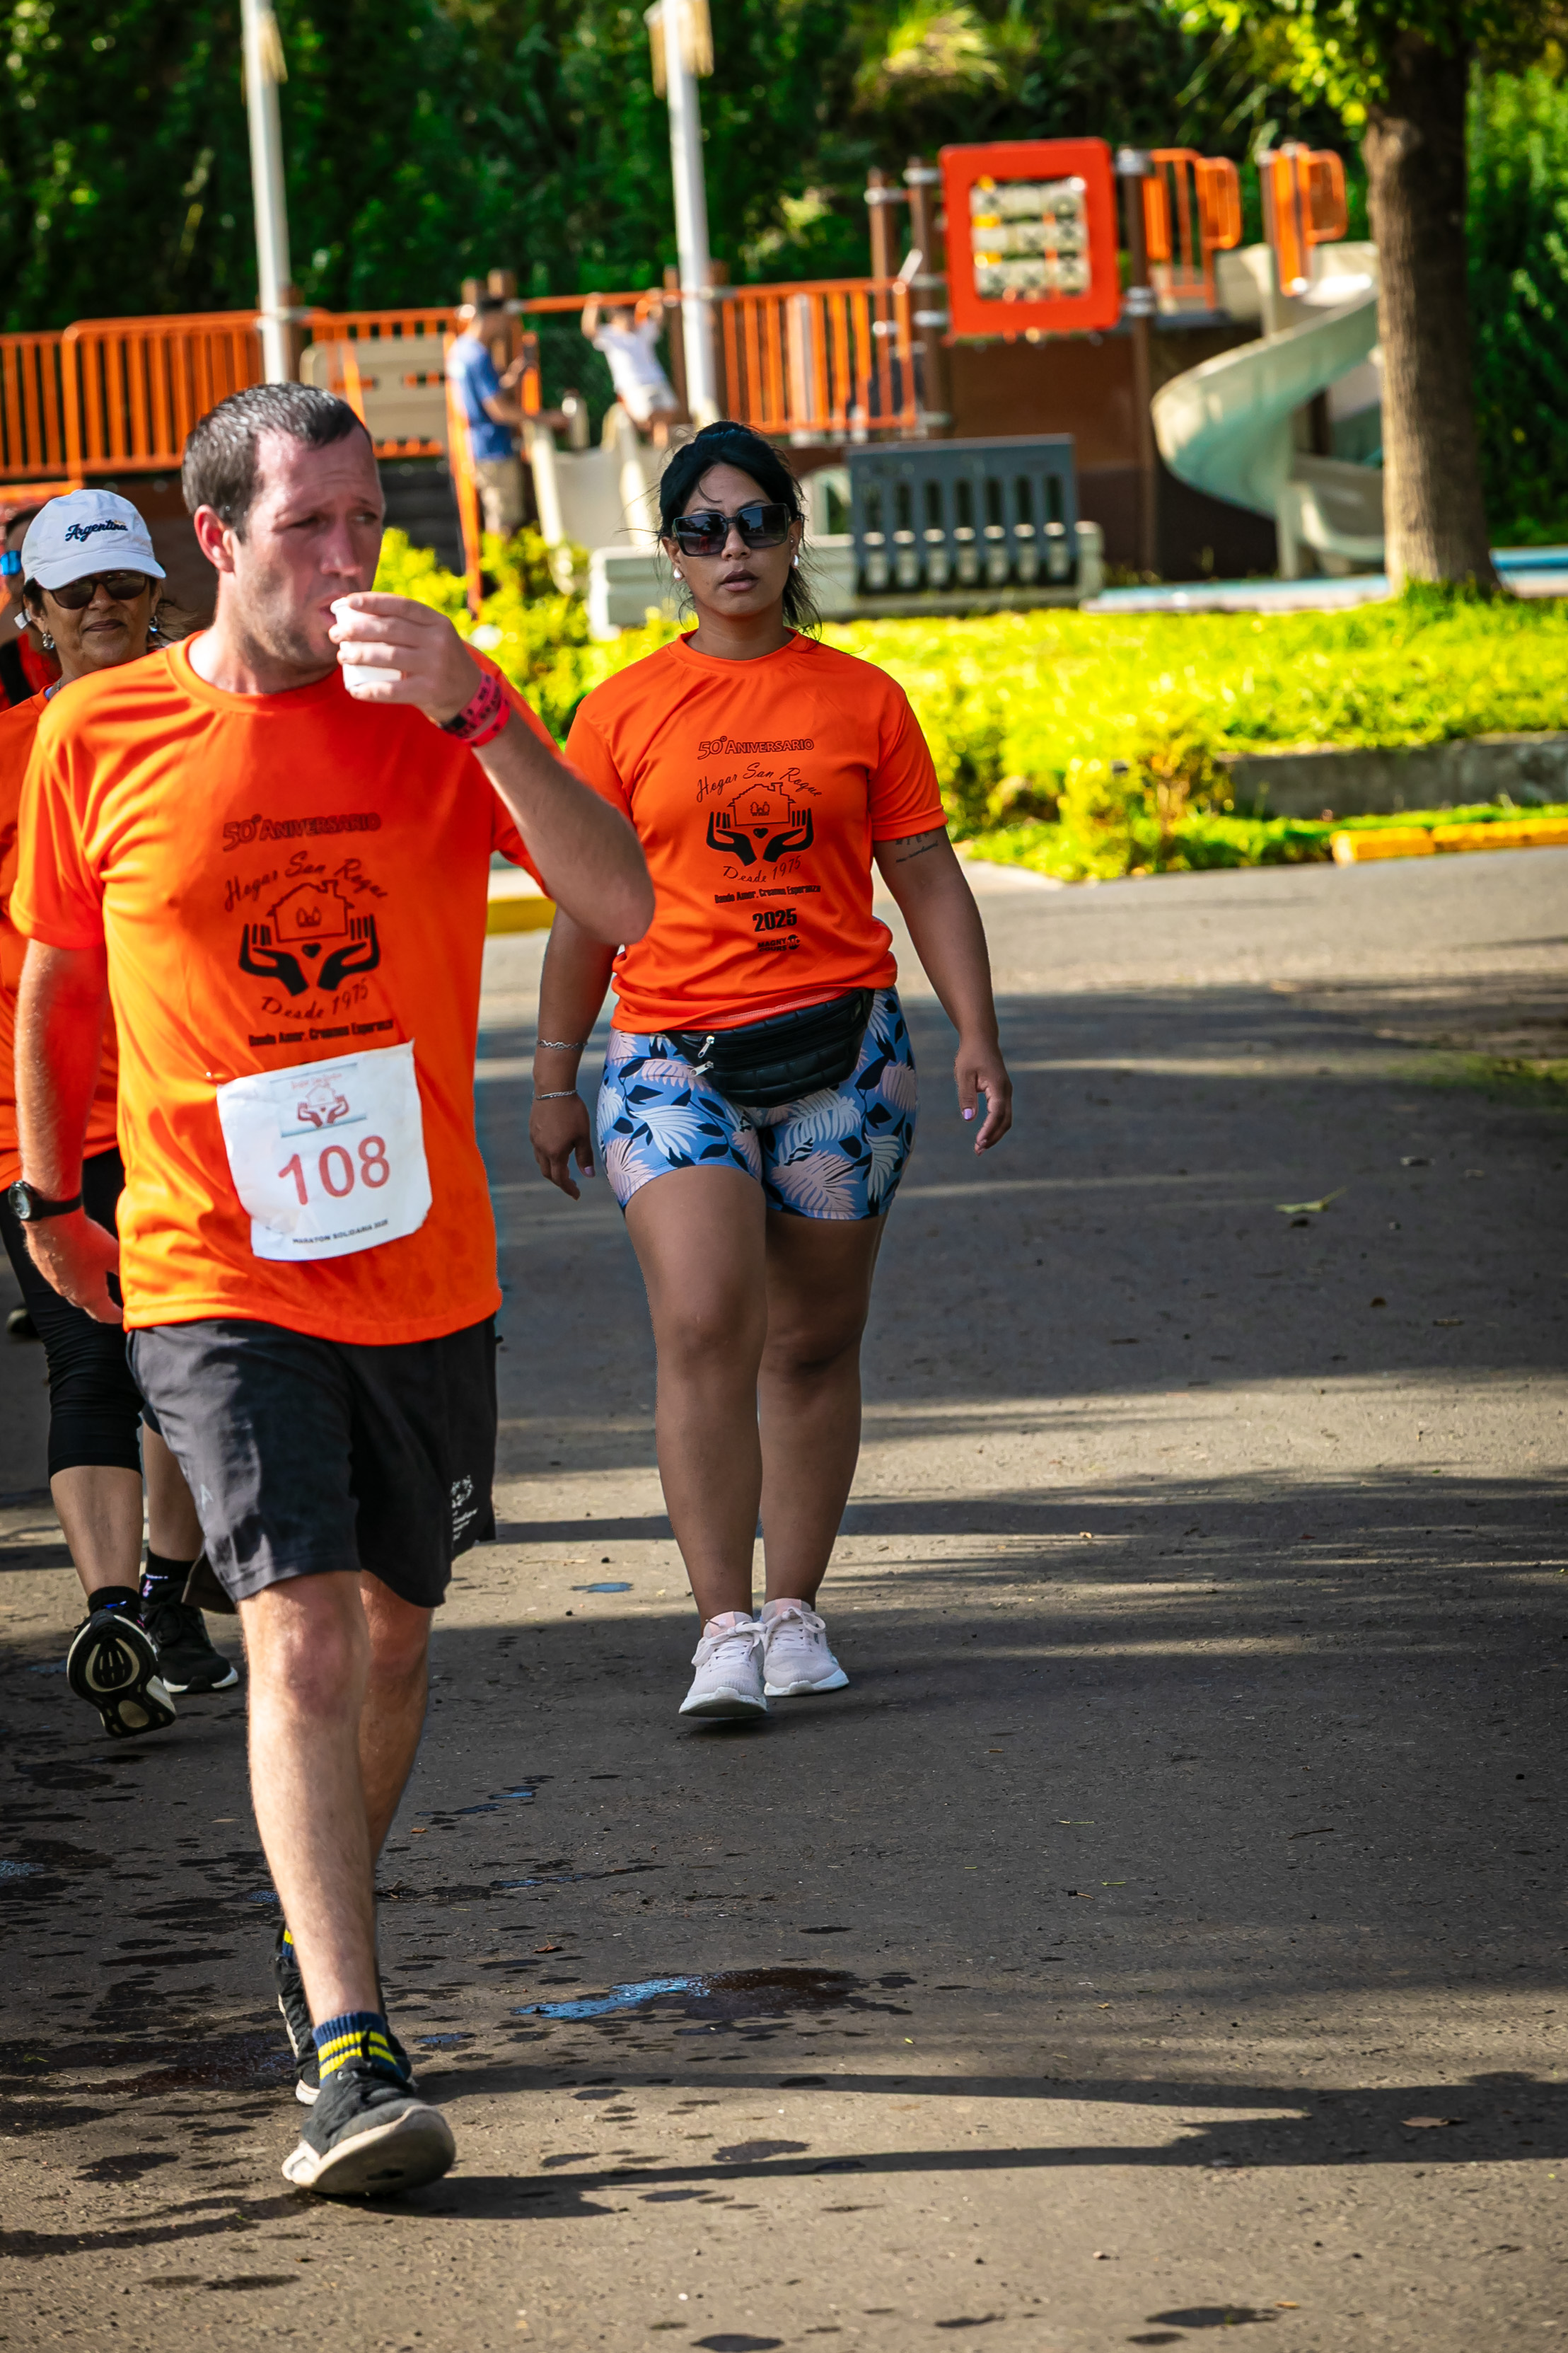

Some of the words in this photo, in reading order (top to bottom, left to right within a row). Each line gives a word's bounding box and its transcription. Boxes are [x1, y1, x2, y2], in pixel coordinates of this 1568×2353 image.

[65, 519, 128, 542] Argentina
[725, 739, 815, 754] ANIVERSARIO
[697, 774, 737, 803] Hogar
[743, 762, 774, 779] San
[779, 768, 822, 797] Roque
[259, 812, 381, 841] ANIVERSARIO
[225, 870, 278, 913] Hogar
[285, 850, 326, 878] San
[723, 866, 766, 882] Desde
[772, 855, 801, 880] 1975
[752, 908, 797, 932] 2025
[757, 937, 786, 949] MAGNY
[262, 996, 324, 1019] Desde
[332, 978, 368, 1014] 1975
[278, 1135, 390, 1206] 108
